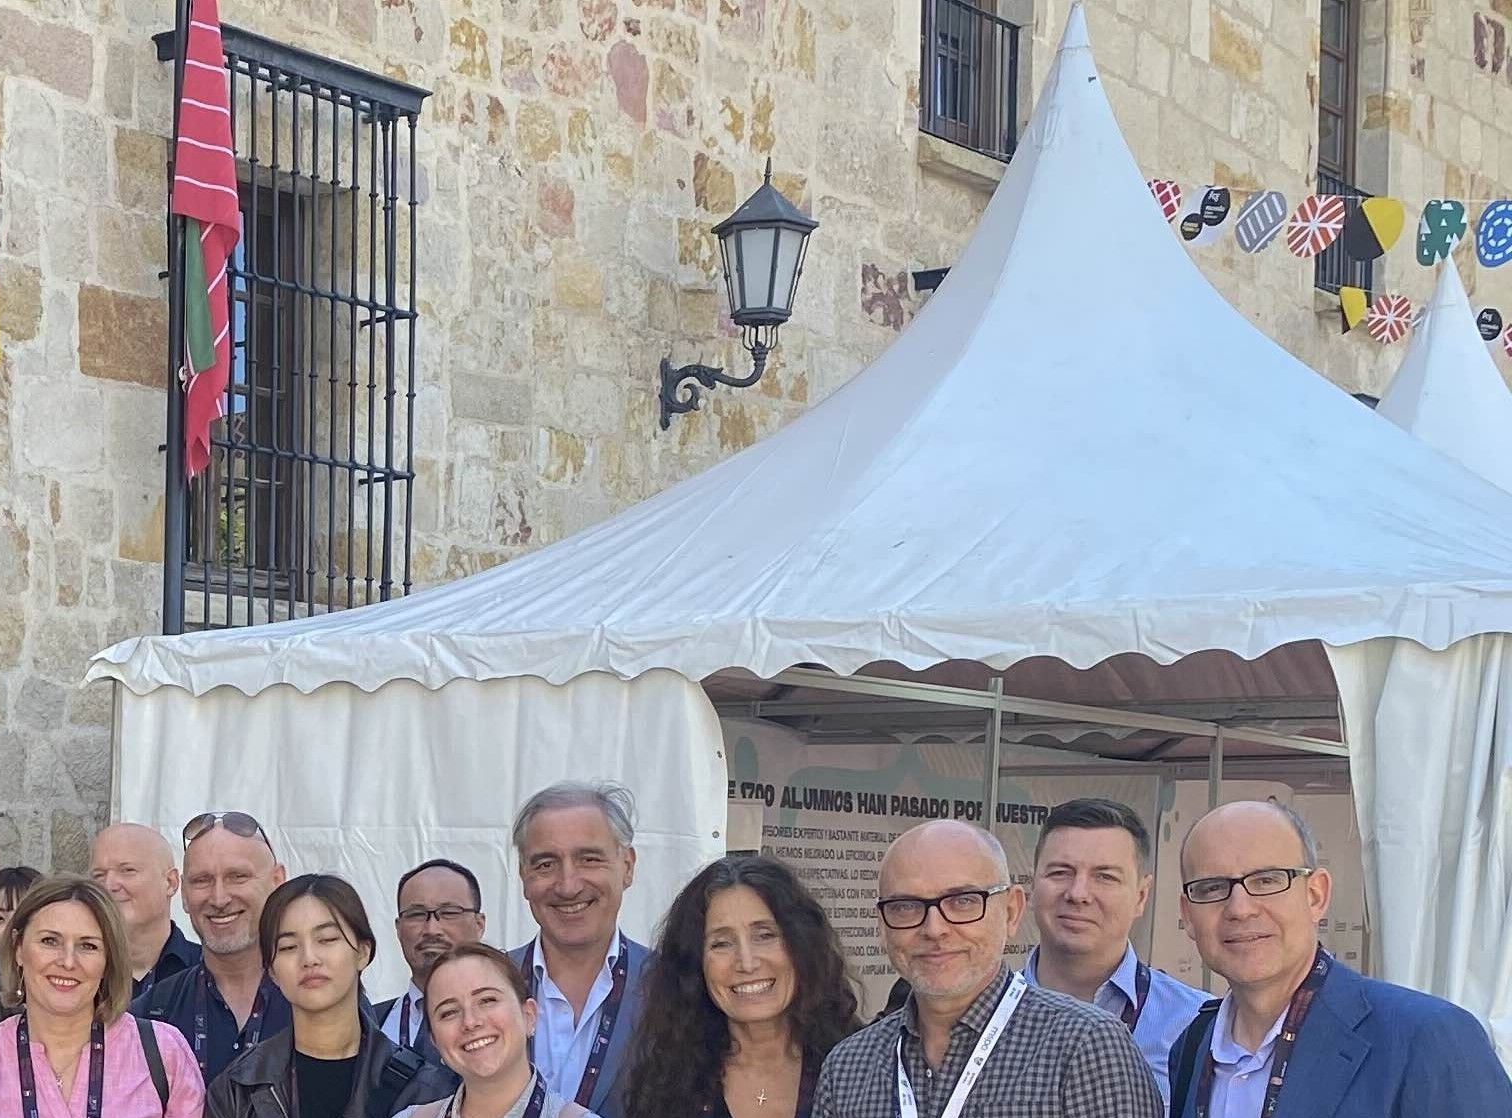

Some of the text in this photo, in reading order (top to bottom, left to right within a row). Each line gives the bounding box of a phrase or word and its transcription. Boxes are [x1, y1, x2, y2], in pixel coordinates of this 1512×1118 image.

[779, 785, 853, 813] ALUMNOS
[856, 792, 887, 815] HAN
[891, 795, 949, 819] PASADO
[996, 802, 1055, 825] NUESTR
